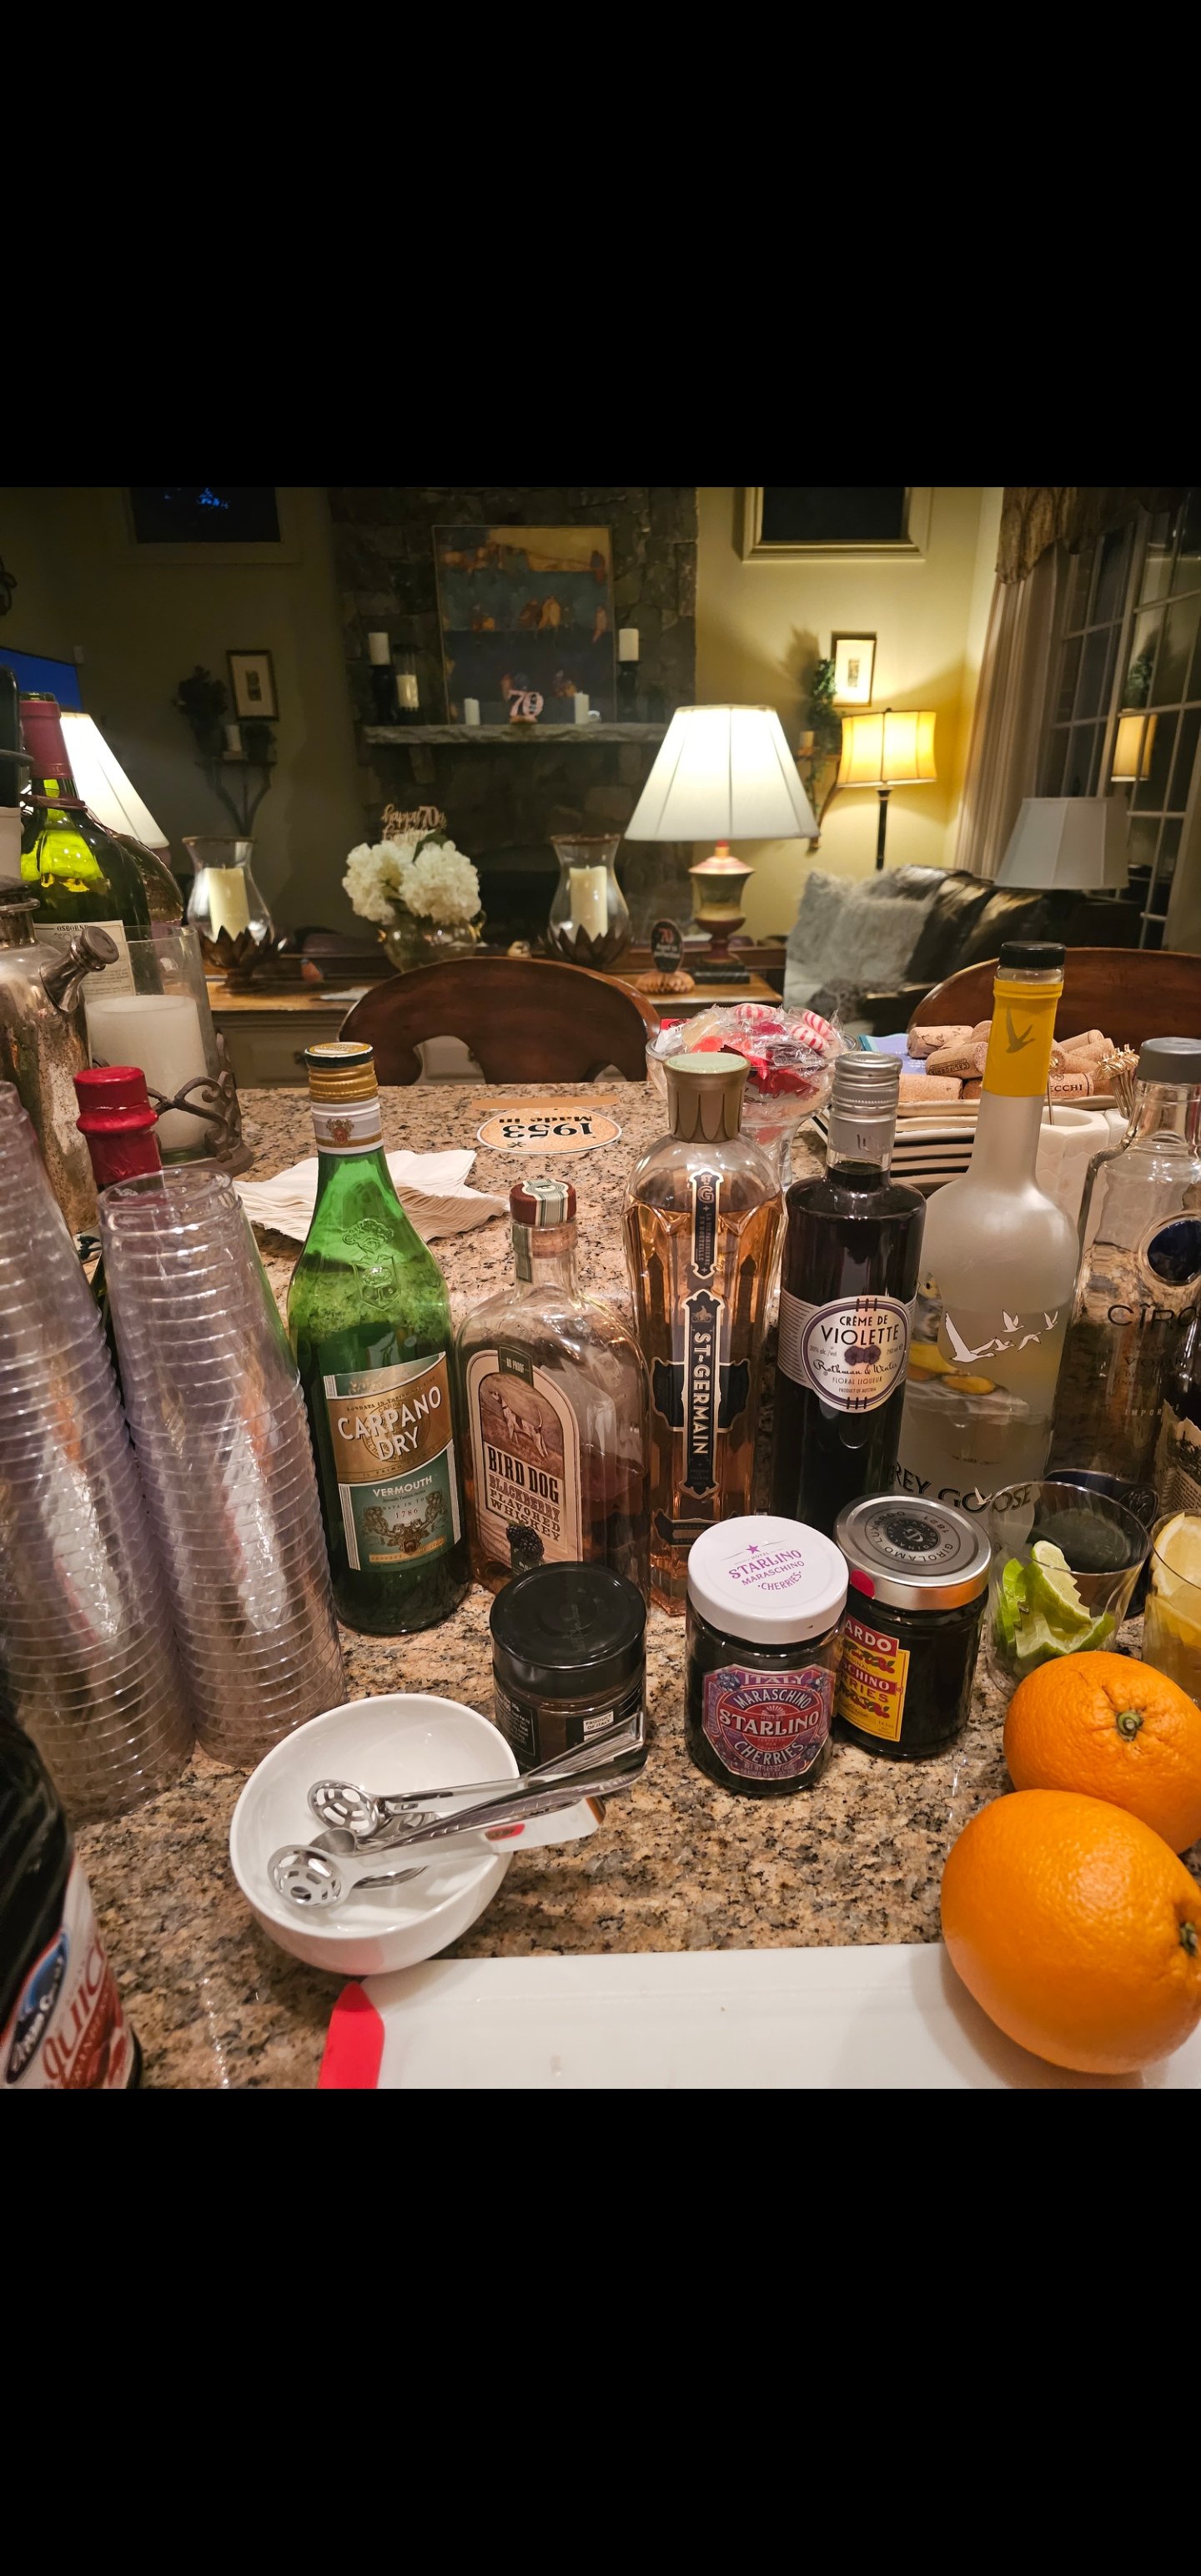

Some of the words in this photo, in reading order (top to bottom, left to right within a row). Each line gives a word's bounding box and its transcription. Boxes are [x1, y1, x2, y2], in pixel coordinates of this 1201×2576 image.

[509, 690, 544, 718] 70
[502, 1123, 593, 1139] 1953
[877, 1315, 888, 1325] DE
[821, 1324, 899, 1346] VIOLETTE
[812, 1359, 862, 1376] Rothman
[864, 1364, 871, 1375] &
[338, 1386, 441, 1441] CARPANO
[375, 1426, 419, 1461] DRY
[372, 1475, 433, 1497] VERMOUTH
[487, 1445, 525, 1487] BIRD
[527, 1466, 560, 1505] DOG
[489, 1473, 560, 1523] BLACKBERRY
[937, 1483, 1033, 1514] GOOSE
[395, 1508, 418, 1519] 1786
[490, 1489, 560, 1533] FLAVORED
[490, 1497, 560, 1542] WHISKEY
[871, 1511, 906, 1543] LUXARDO
[923, 1515, 950, 1533] 1821
[728, 1549, 802, 1579] STARLINO
[884, 1543, 953, 1562] GIROLAMO
[741, 1560, 805, 1586] MARASCHINO
[845, 1619, 892, 1652] ARDO
[745, 1674, 805, 1685] ITALY
[733, 1688, 812, 1709] MARASCHINO
[585, 1713, 611, 1726] PRODUCT
[595, 1718, 611, 1728] ITALY
[720, 1708, 819, 1736] STARLINO
[734, 1742, 804, 1766] CHERRIES
